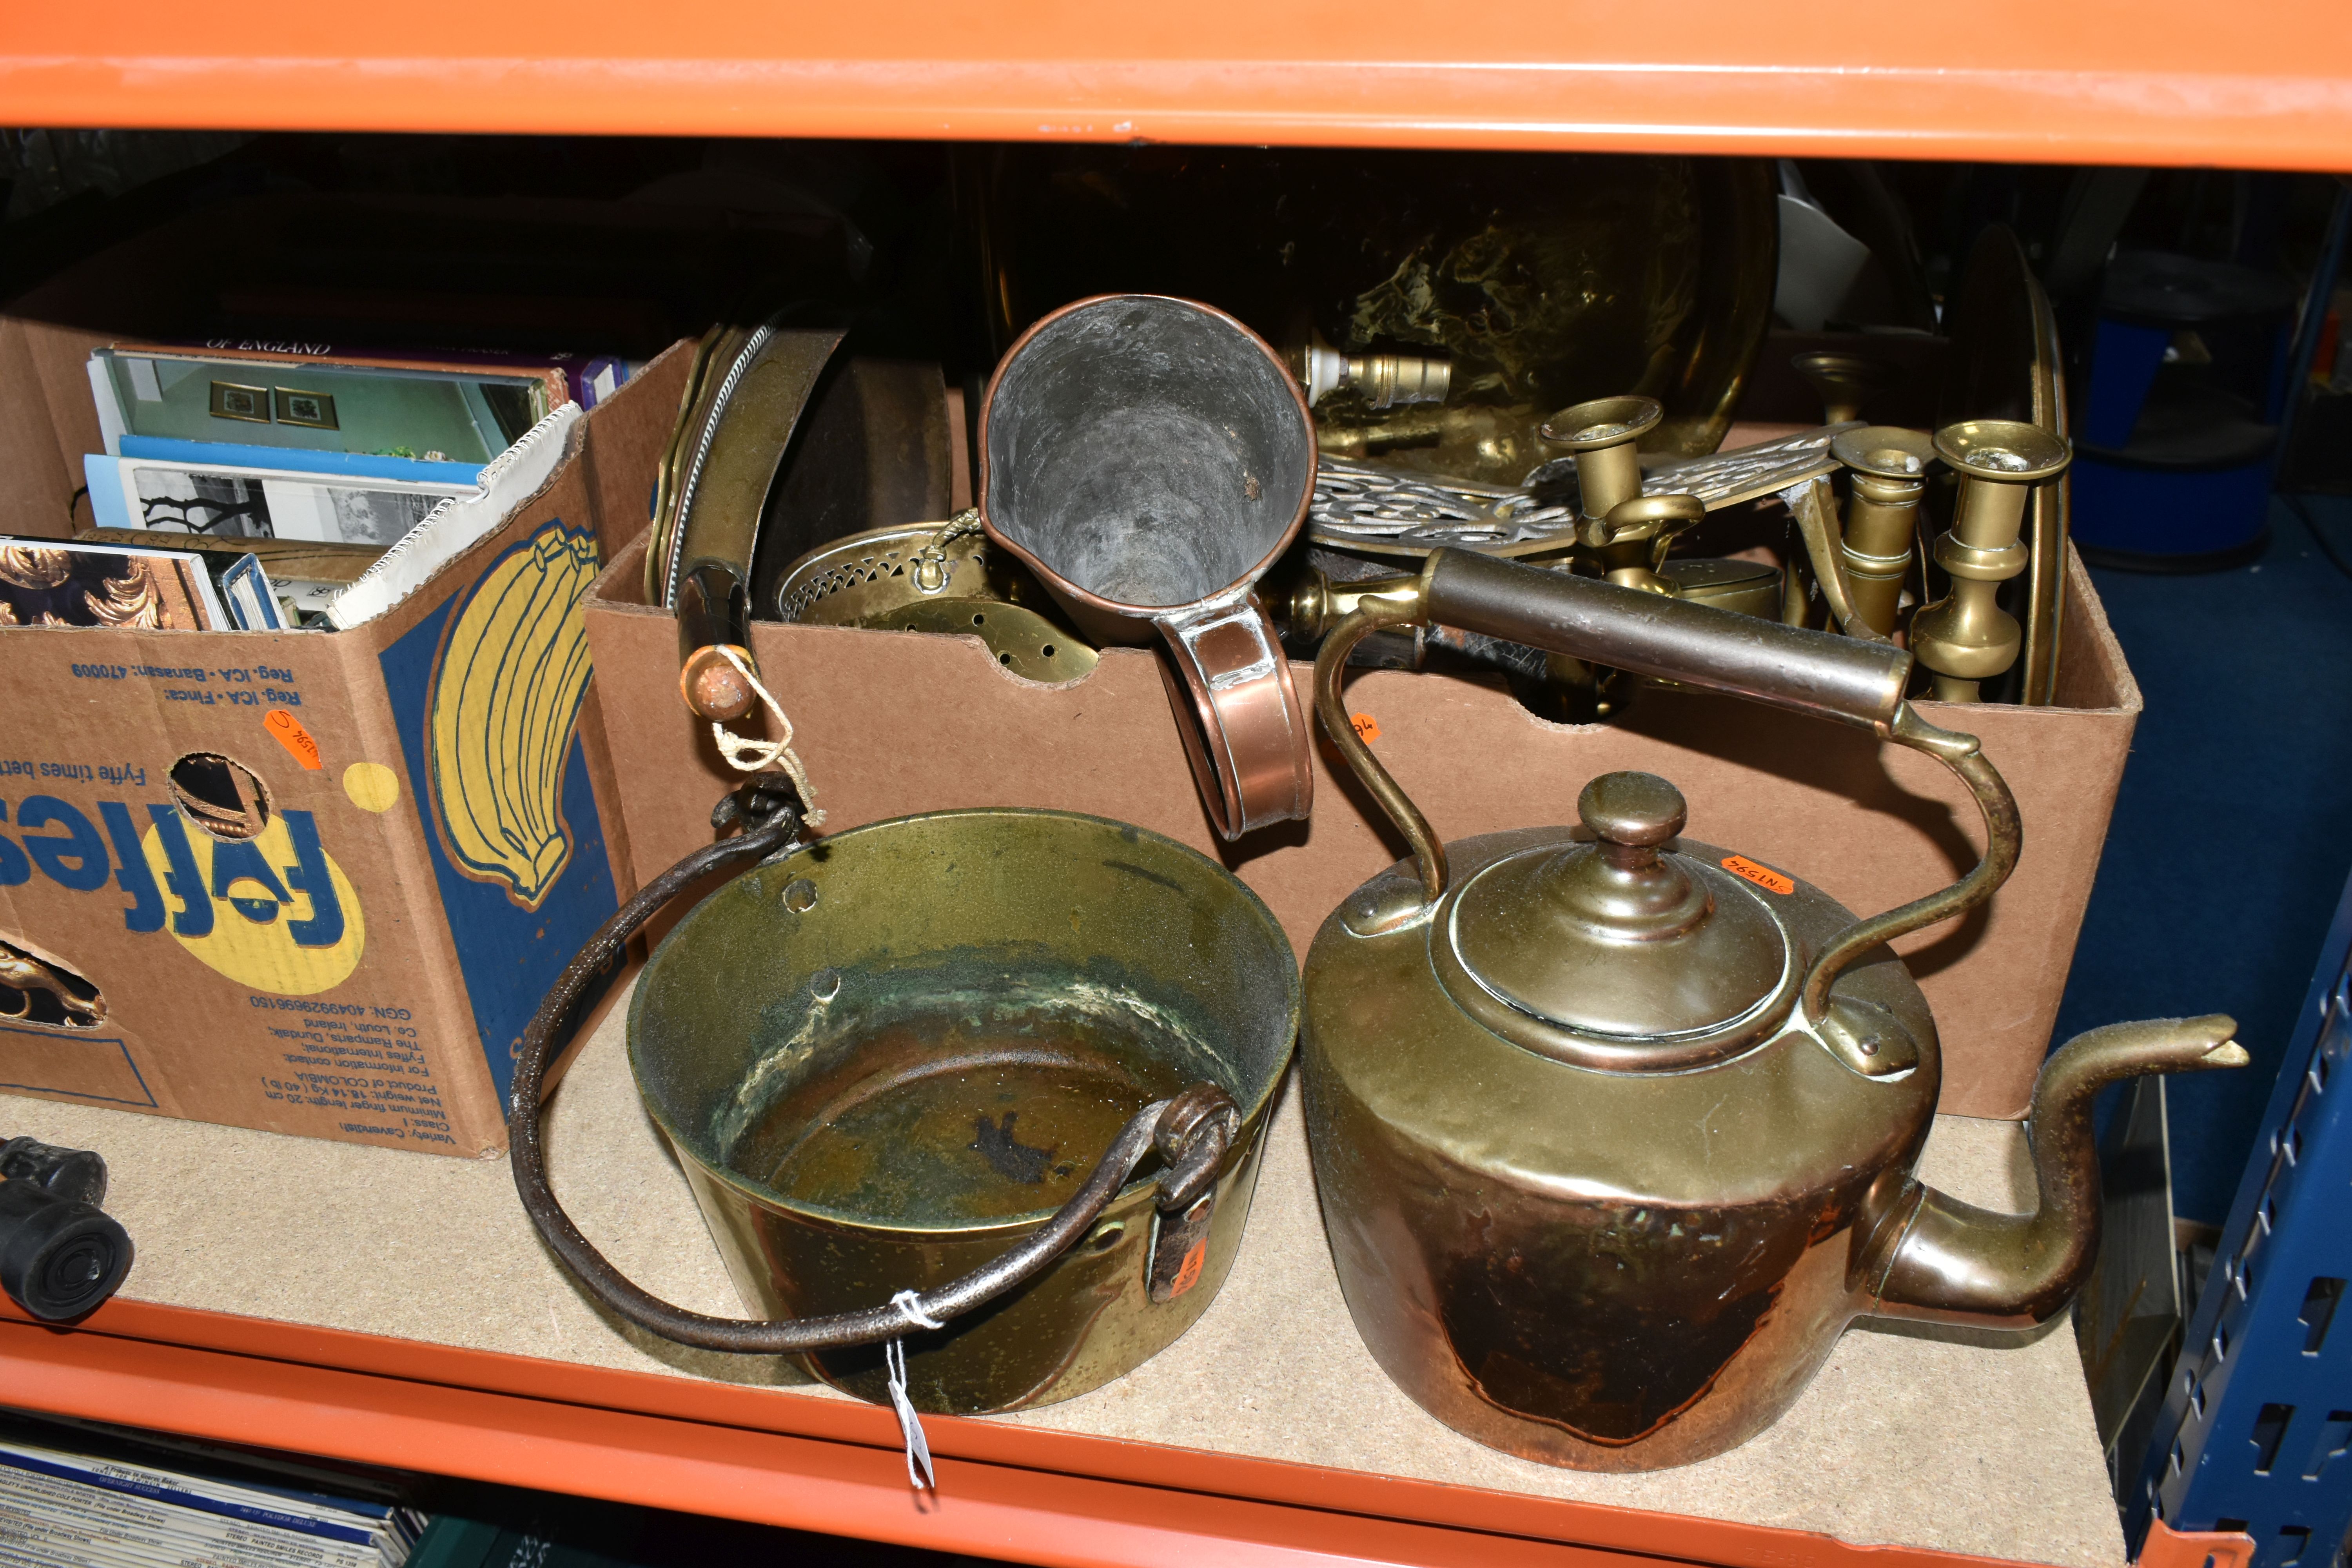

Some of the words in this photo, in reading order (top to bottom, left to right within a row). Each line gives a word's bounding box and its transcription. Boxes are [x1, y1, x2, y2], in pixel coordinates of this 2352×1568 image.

[207, 339, 232, 349] OF
[238, 339, 330, 355] ENGLAND
[71, 663, 128, 680] 470009
[131, 664, 207, 682] Banasan:
[217, 668, 250, 683] ICA
[252, 665, 295, 683] Reg.
[163, 689, 217, 706] Finca:
[226, 691, 260, 706] ICA
[261, 688, 303, 707] Reg.
[40, 762, 94, 784] times
[98, 762, 146, 786] Fyffe
[1728, 860, 1779, 887] N1594
[249, 995, 366, 1016] 4049929696150
[368, 1006, 412, 1021] GGN:
[303, 1018, 347, 1031] Ireland
[350, 1022, 390, 1035] Louth,
[397, 1027, 417, 1038] Co.
[327, 1033, 393, 1049] Ramparts,
[396, 1039, 422, 1051] The
[301, 1042, 383, 1060] International;
[387, 1051, 426, 1064] Fyffes
[283, 1053, 331, 1066] contact:
[334, 1060, 404, 1074] information
[294, 1071, 369, 1088] COLOMBIA
[408, 1066, 430, 1078] For
[311, 1083, 328, 1095] Kg
[372, 1079, 385, 1088] of
[387, 1080, 438, 1095] Product
[265, 1091, 284, 1100] cm
[287, 1094, 304, 1104] 20
[332, 1088, 367, 1099] 18.14
[370, 1091, 415, 1102] weight:
[305, 1096, 348, 1110] length:
[350, 1100, 387, 1113] finger
[419, 1096, 442, 1108] Net
[388, 1104, 446, 1120] Minimum
[338, 1122, 405, 1139] Cavendish
[414, 1119, 451, 1132] Class:
[409, 1129, 457, 1145] Variety:
[20, 1484, 56, 1496] UNPUBLISHED
[71, 1496, 92, 1506] PORTER
[121, 1509, 146, 1520] Broadway
[99, 1476, 134, 1488] OVERNIGHT
[134, 1484, 160, 1494] SUCCESS
[262, 1511, 291, 1522] POLYDOR
[292, 1517, 317, 1528] DELUXE
[22, 1523, 34, 1531] (File
[49, 1528, 73, 1540] Broadway
[73, 1534, 91, 1544] Shows)
[225, 1532, 248, 1542] STEREO
[251, 1538, 276, 1548] PAINTED
[276, 1543, 296, 1553] SMILES
[296, 1548, 324, 1559] RECORDS
[180, 1559, 202, 1568] STEREO
